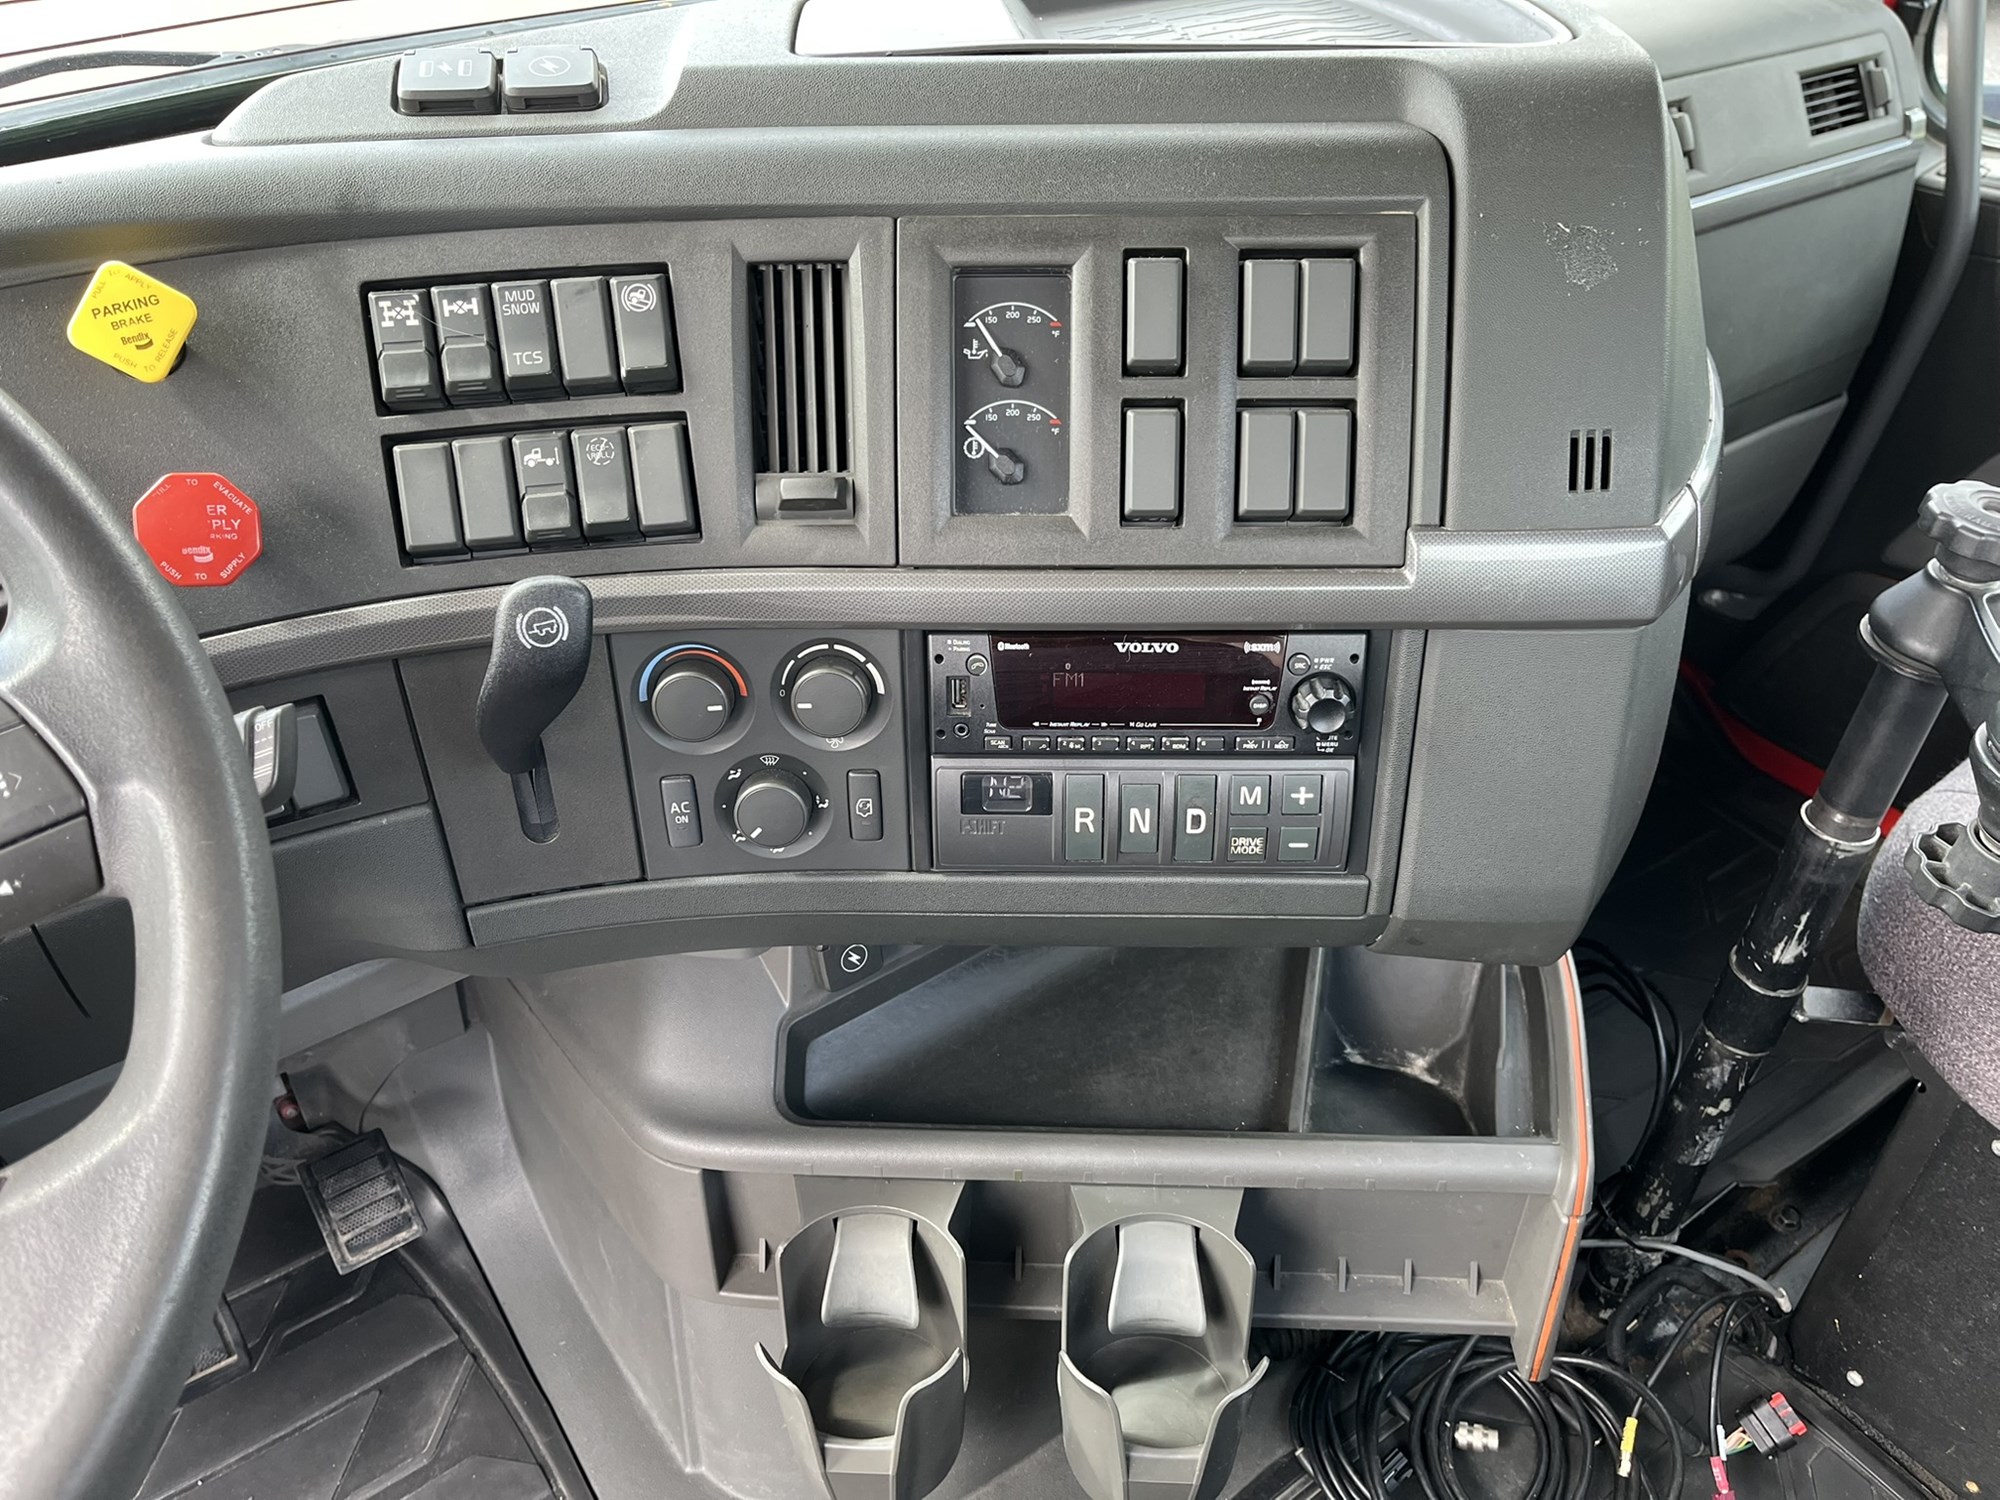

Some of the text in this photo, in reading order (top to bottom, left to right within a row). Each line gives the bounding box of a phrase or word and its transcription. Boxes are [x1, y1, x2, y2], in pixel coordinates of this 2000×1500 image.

[504, 289, 535, 303] MUD
[91, 294, 160, 319] PARKING
[502, 302, 540, 316] SNOW
[110, 312, 153, 331] BRAKE
[985, 311, 1042, 324] 150 200 250
[120, 332, 150, 346] Bendix
[113, 328, 178, 373] PUSH TO RELEASE
[513, 351, 543, 365] TCS
[1005, 409, 1020, 417] 200
[1026, 413, 1041, 421] 250
[186, 478, 199, 486] TO
[213, 481, 253, 515] EVACUATE
[160, 561, 183, 580] PUSH
[219, 552, 246, 579] SUPPLY
[1114, 642, 1179, 653] VOLVO
[1052, 672, 1084, 687] FM1
[254, 719, 273, 732] OFF
[1240, 786, 1262, 806] M
[670, 801, 691, 814] AC
[675, 815, 689, 824] ON
[1075, 807, 1095, 834] R
[1129, 808, 1150, 833] N
[1186, 809, 1207, 834] D
[1231, 837, 1264, 846] DRIVE
[1230, 846, 1264, 855] MODE
